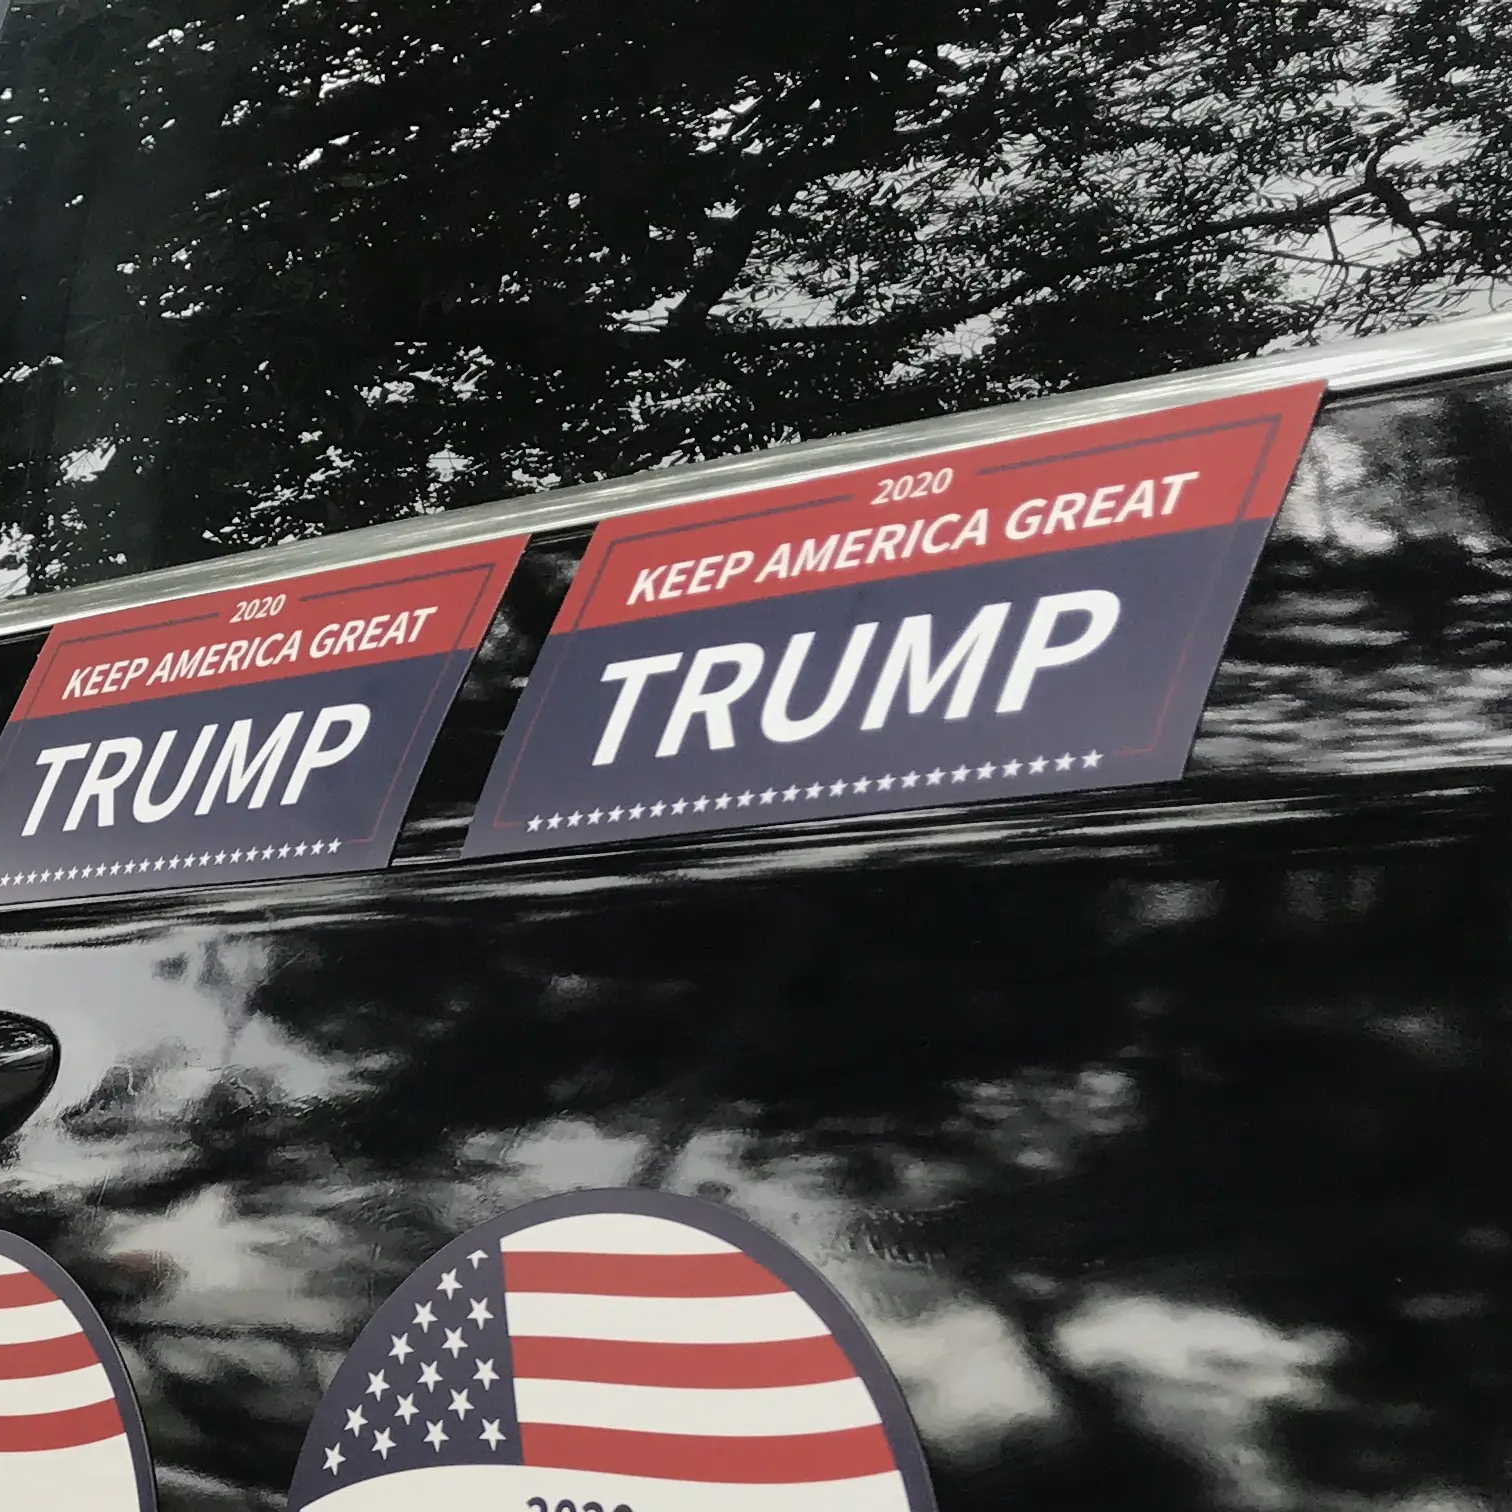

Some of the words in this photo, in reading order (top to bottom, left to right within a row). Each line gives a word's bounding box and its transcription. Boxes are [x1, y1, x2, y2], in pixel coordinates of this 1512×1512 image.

[626, 550, 755, 606] KEEP
[754, 507, 990, 584] AMERICA
[1003, 470, 1201, 542] GREAT
[870, 468, 954, 506] 2020
[61, 657, 149, 700] KEEP
[144, 630, 303, 687] AMERICA
[309, 605, 439, 659] GREAT
[229, 594, 287, 624] 2020
[591, 589, 1122, 767] TRUMP
[20, 703, 372, 837] TRUMP
